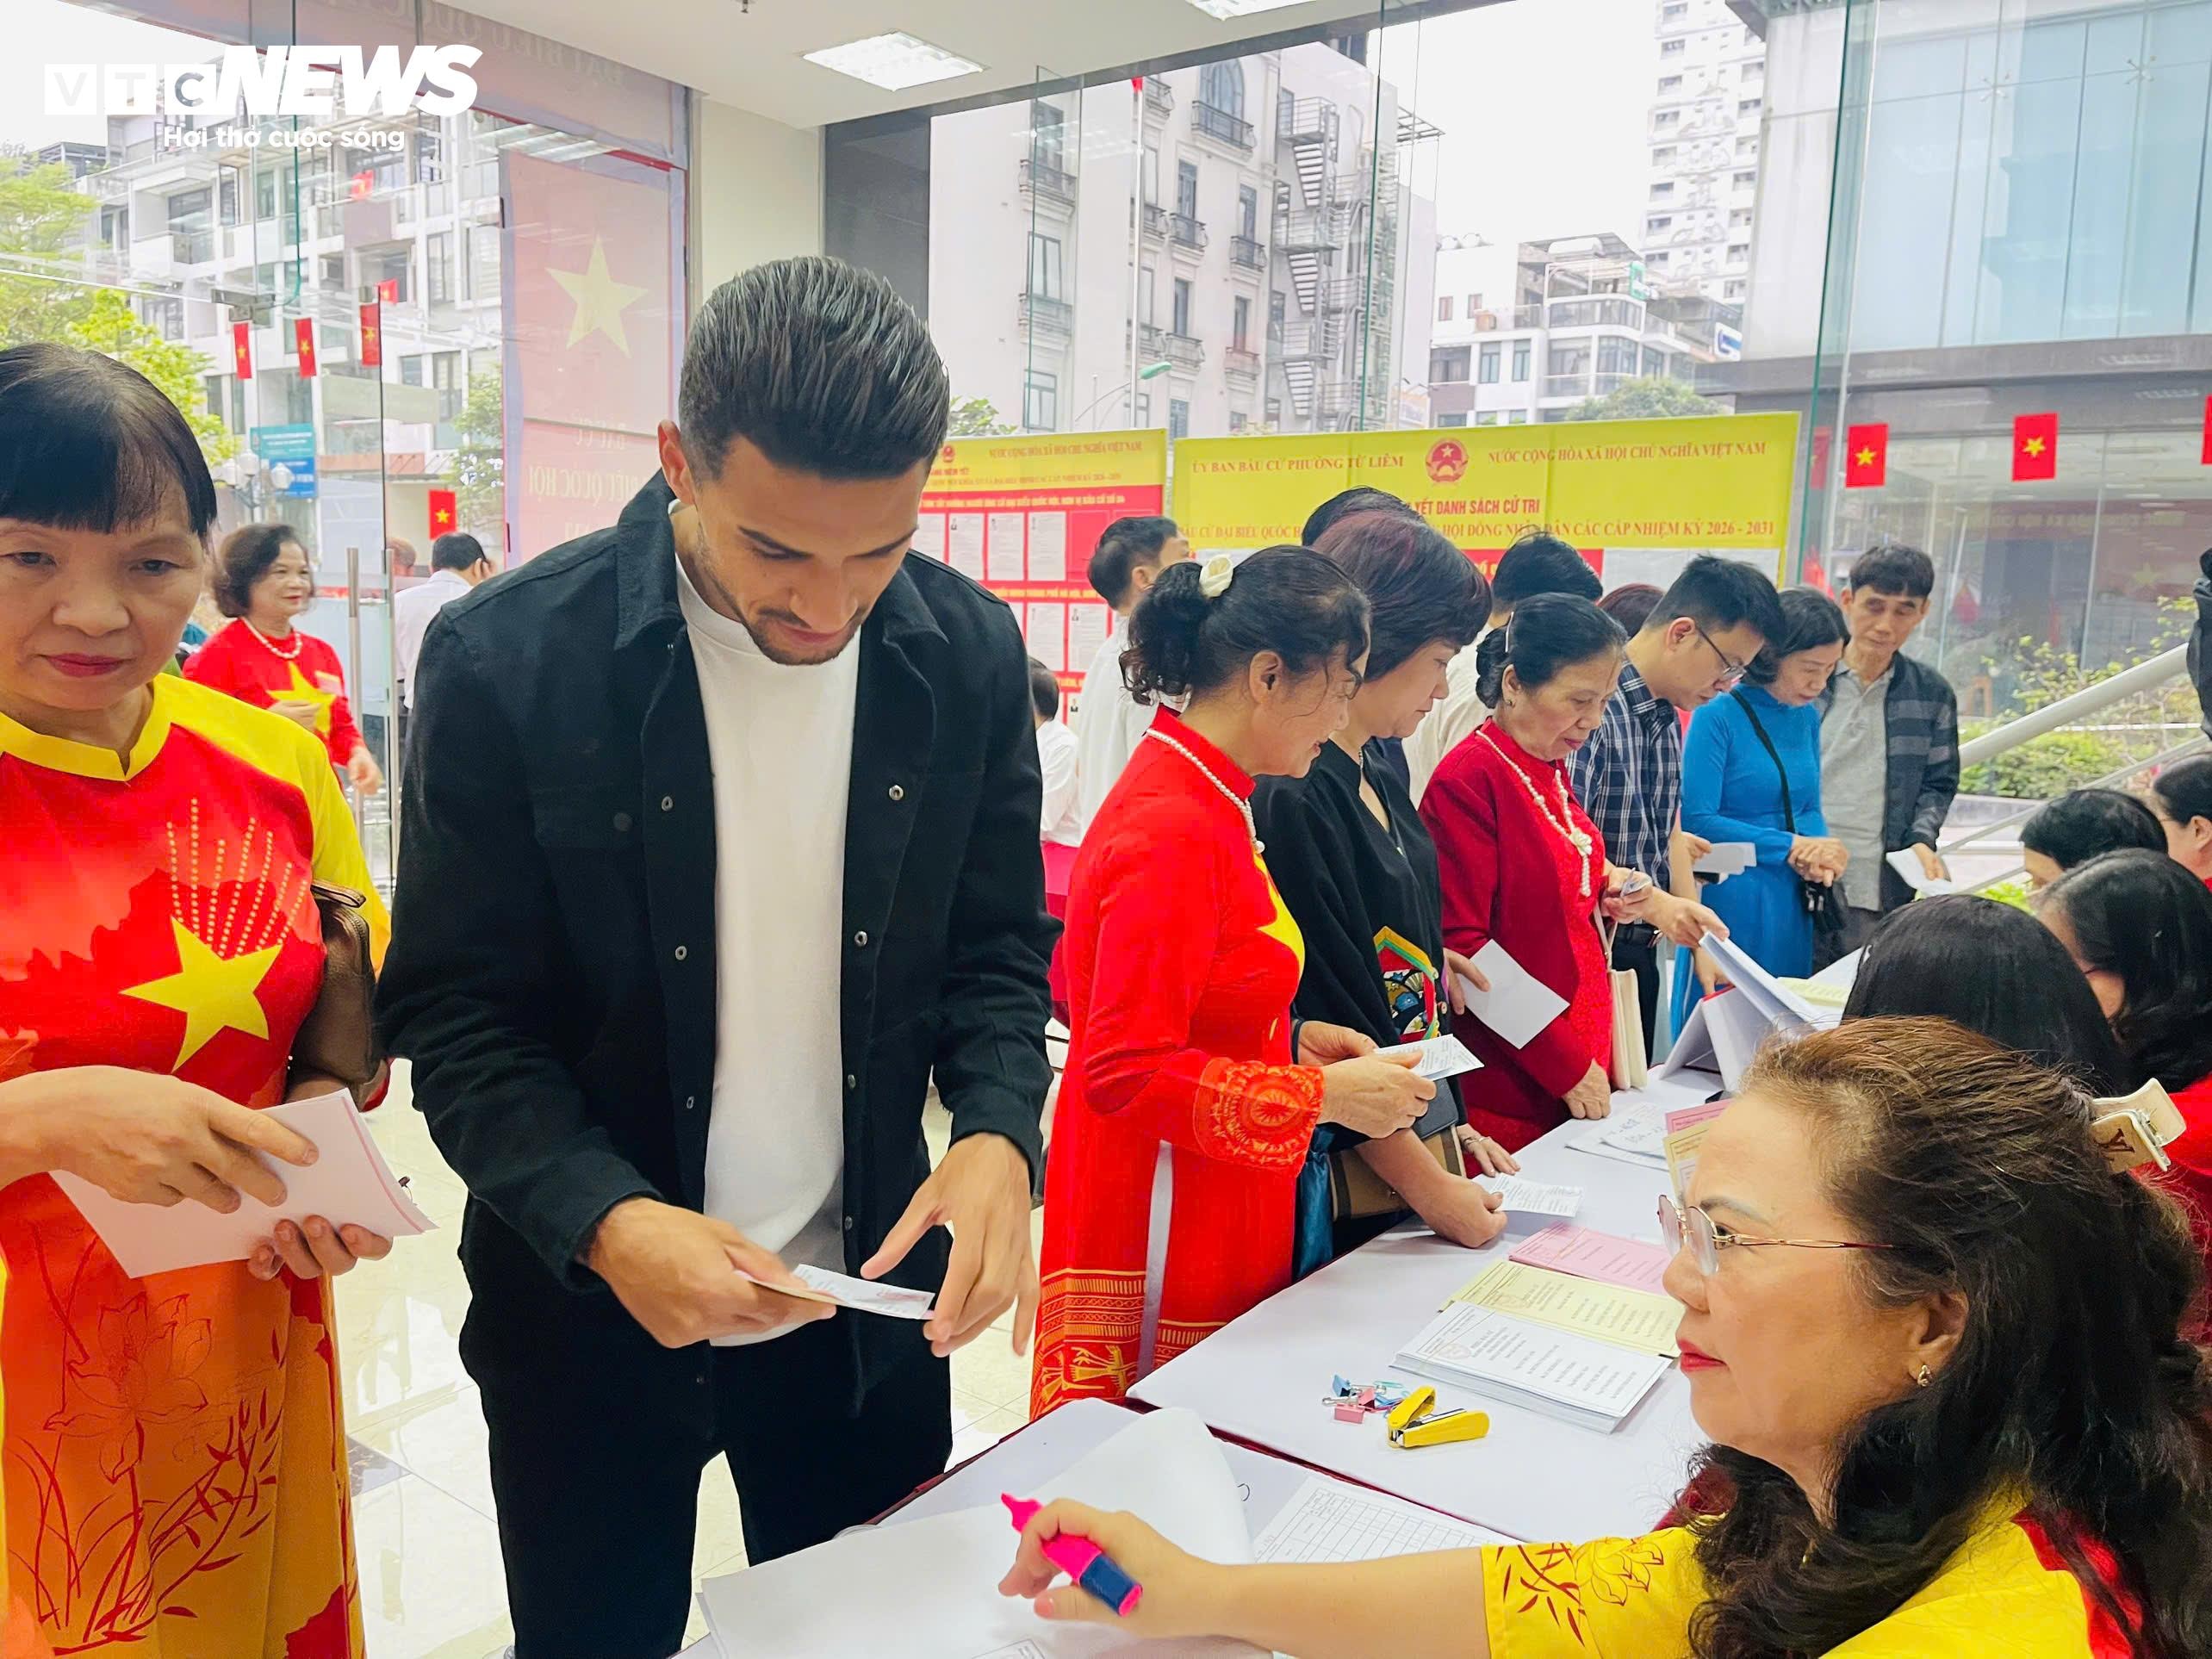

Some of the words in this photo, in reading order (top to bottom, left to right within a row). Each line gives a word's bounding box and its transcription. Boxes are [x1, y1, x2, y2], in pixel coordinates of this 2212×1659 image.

[1488, 448, 1520, 462] NƯỚC
[1523, 449, 1555, 463] CỘNG
[1557, 445, 1583, 461] HÒA
[1586, 445, 1601, 460] XÃ
[1606, 445, 1627, 462] HỘI
[1659, 442, 1699, 457] NGHĨA
[1702, 442, 1733, 459] VIỆT
[1736, 441, 1767, 456] NAM
[1211, 461, 1235, 472] BAN
[1415, 497, 1433, 515] YẾT
[1437, 500, 1466, 514] DANH
[1469, 497, 1500, 514] SÁCH
[1523, 499, 1540, 513] TRI
[1634, 520, 1679, 538] NHIỆM
[1707, 521, 1735, 535] 2026
[1746, 521, 1774, 535] 2031
